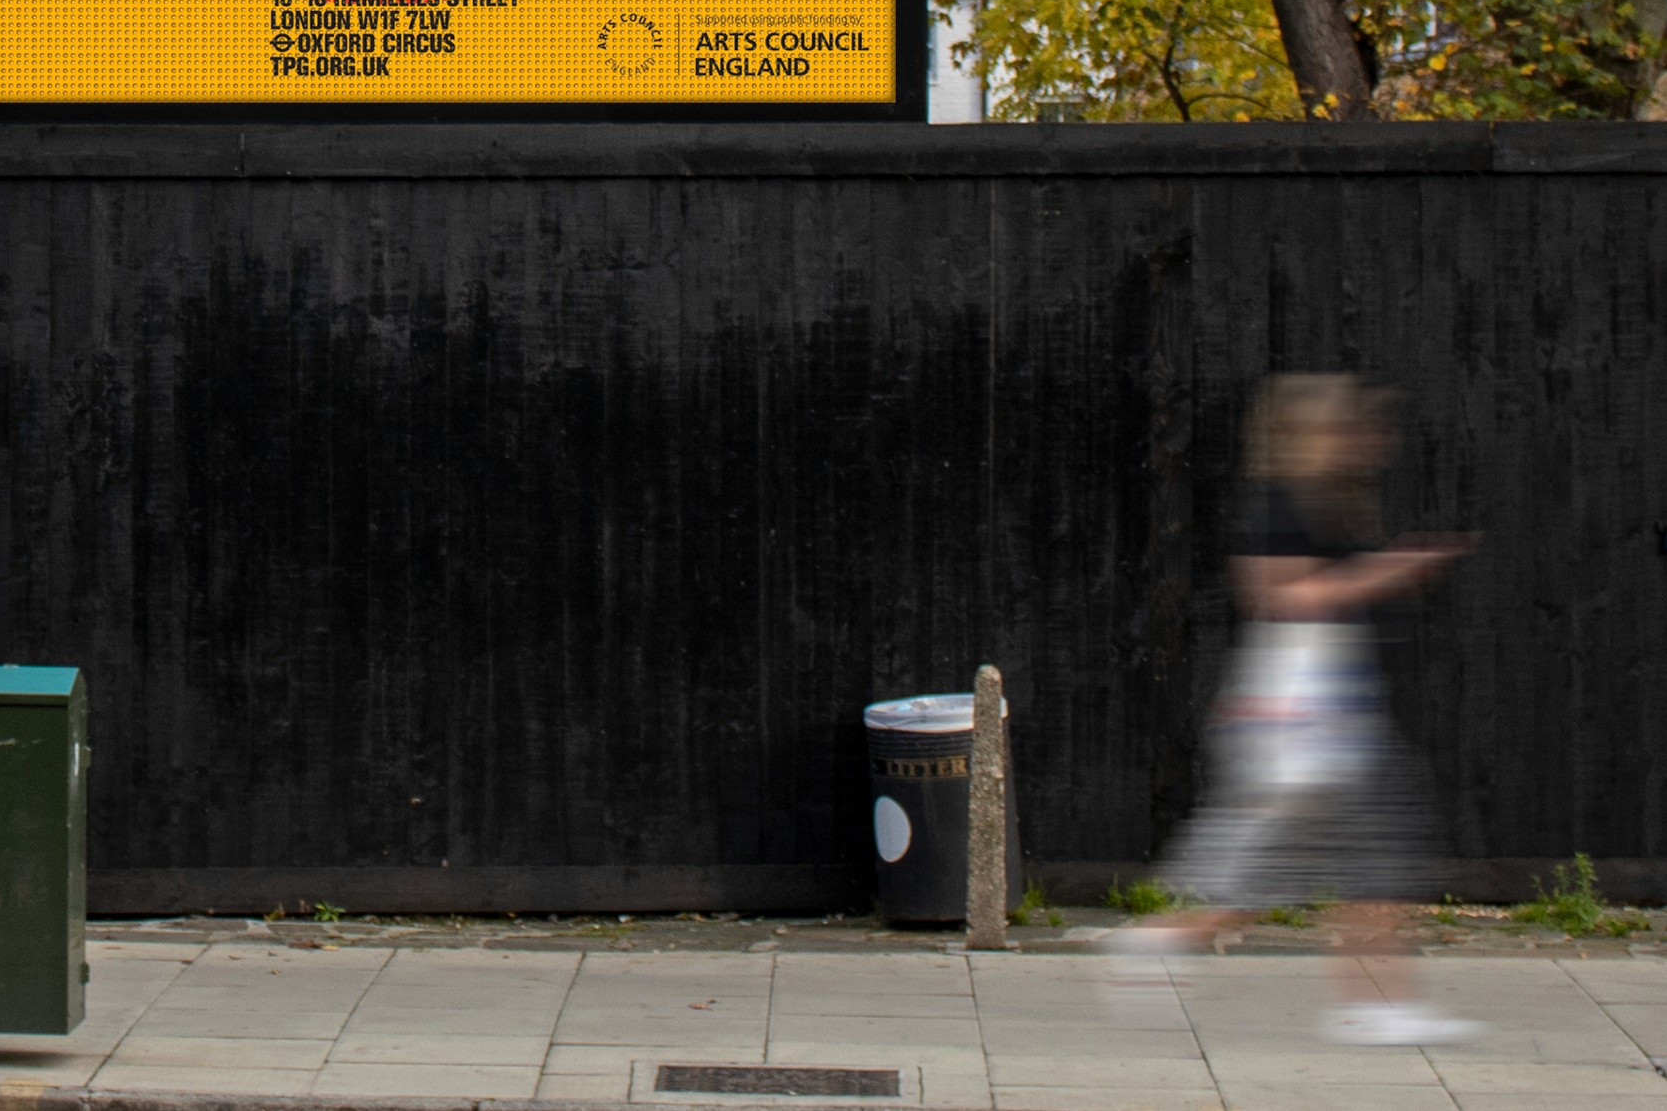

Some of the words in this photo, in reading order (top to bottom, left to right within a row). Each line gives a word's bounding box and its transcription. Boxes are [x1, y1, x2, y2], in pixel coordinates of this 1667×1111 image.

[270, 10, 350, 30] LONDON
[357, 10, 400, 30] W1F
[406, 10, 451, 30] 7LW
[695, 13, 747, 25] Supported
[749, 13, 775, 26] using
[777, 13, 808, 25] public
[809, 13, 848, 26] funding
[849, 13, 862, 25] by
[597, 19, 618, 50] ARTS
[619, 13, 663, 50] COUNCIL
[298, 33, 375, 53] OXFORD
[384, 33, 456, 53] CIRCUS
[695, 33, 757, 51] ARTS
[765, 33, 869, 51] COUNCIL
[270, 56, 390, 77] TPG.ORG.UK
[605, 57, 656, 77] ENGLAND
[695, 57, 810, 76] ENGLAND
[886, 757, 968, 777] LITTER
